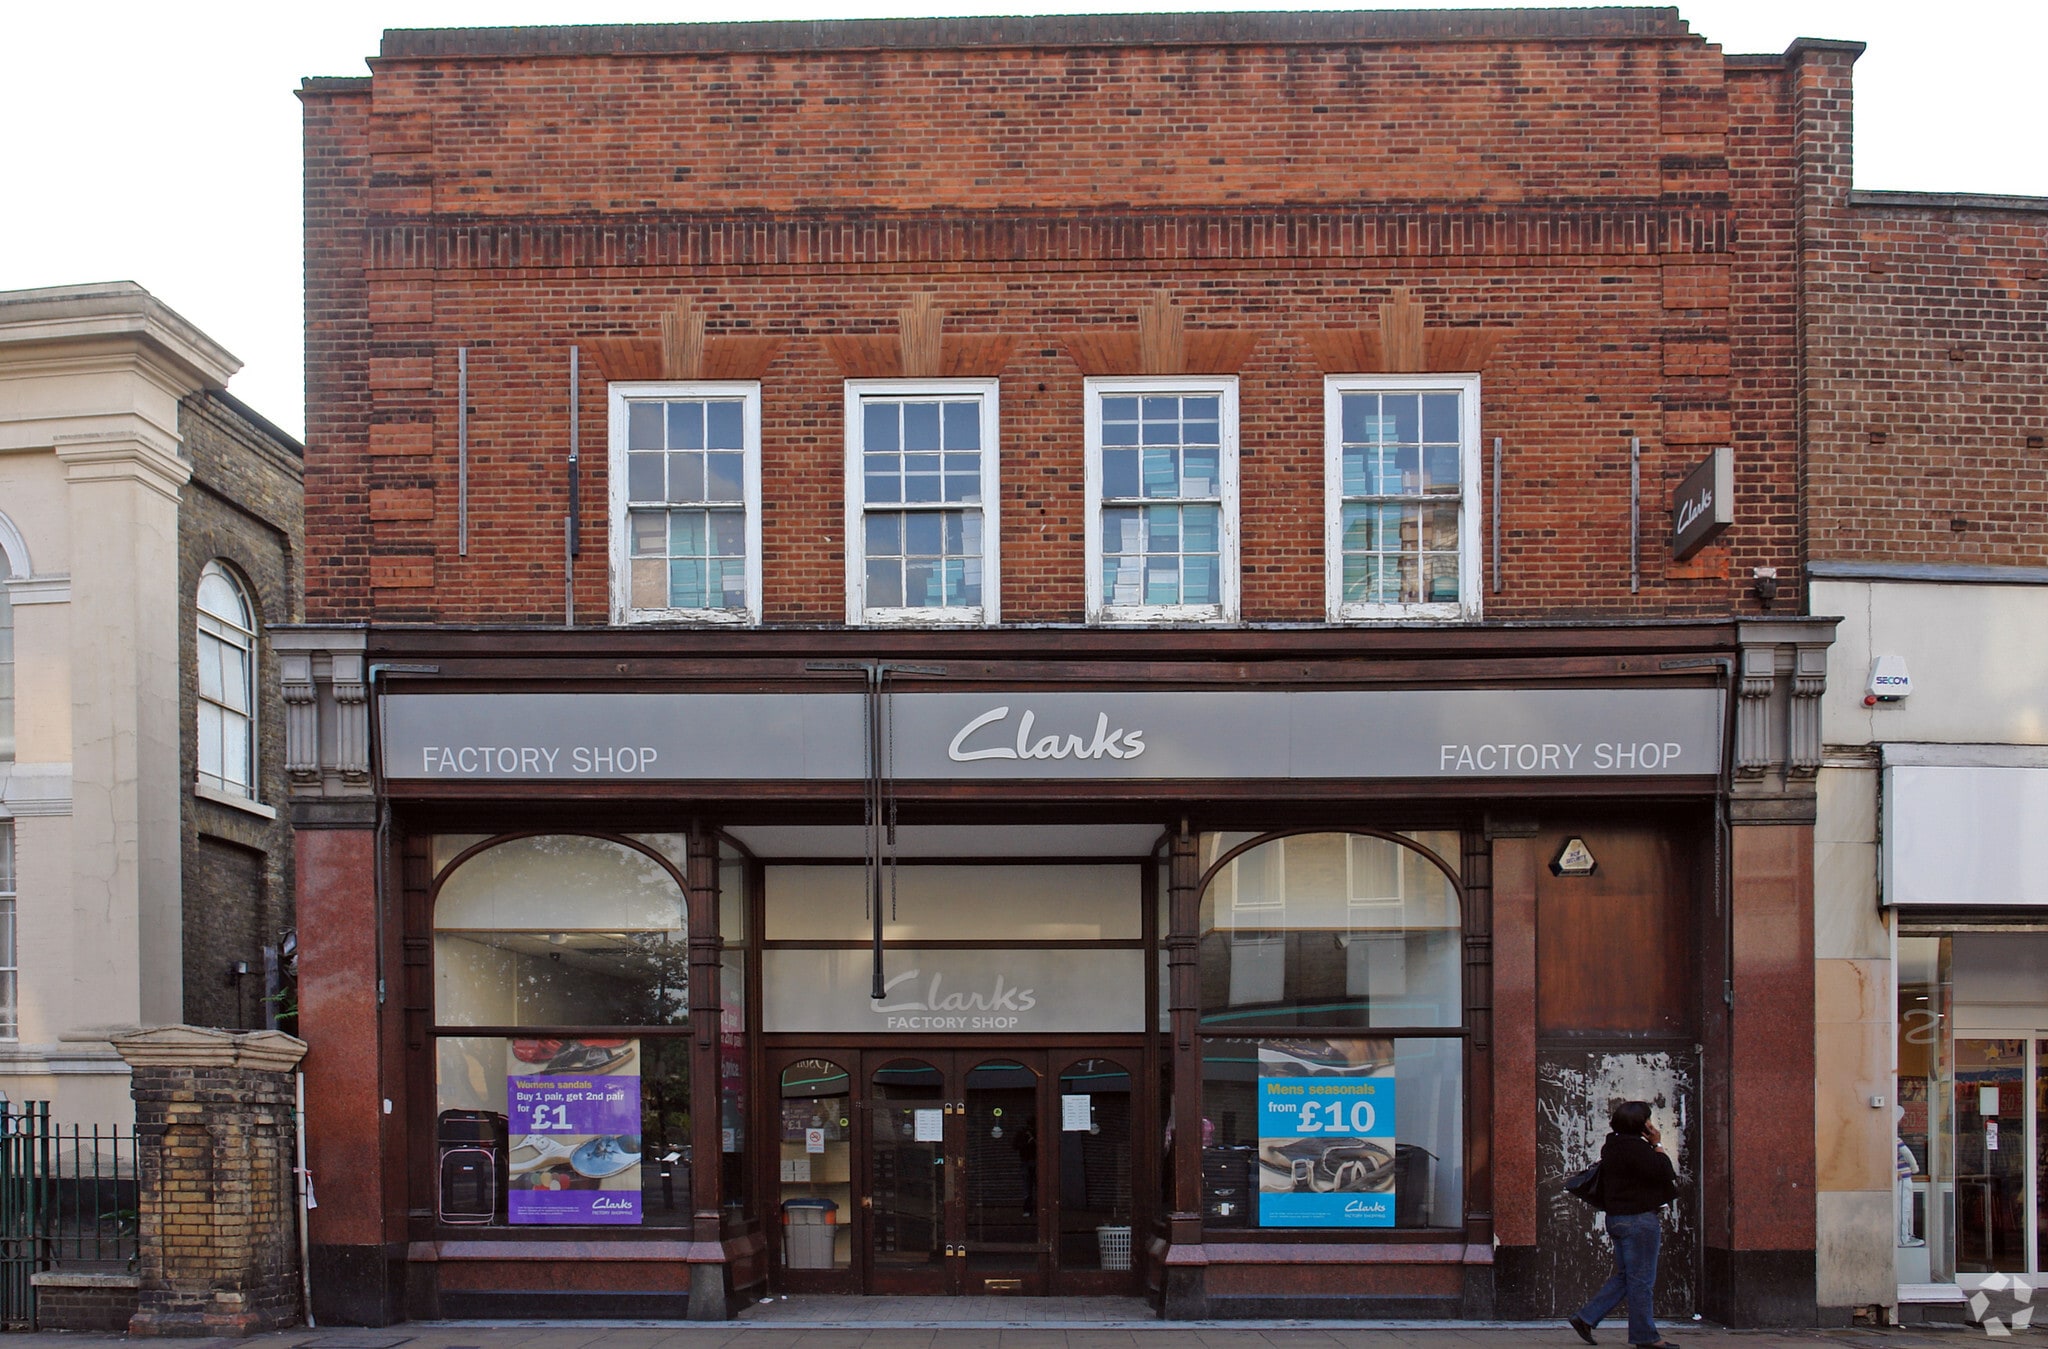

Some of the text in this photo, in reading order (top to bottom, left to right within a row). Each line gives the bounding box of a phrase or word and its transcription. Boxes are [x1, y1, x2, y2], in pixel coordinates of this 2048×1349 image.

[1677, 487, 1713, 535] Clarks
[1876, 676, 1908, 685] SECOM
[948, 706, 1146, 761] Clarks
[423, 746, 658, 773] FACTORY SHOP
[1440, 742, 1681, 771] FACTORY SHOP
[871, 969, 1036, 1013] Clarks
[887, 1016, 1018, 1029] FACTORY SHOP
[516, 1081, 593, 1089] Womens sandals
[1267, 1083, 1375, 1095] Mens seasonals
[516, 1092, 624, 1102] Buy 1 pair, get 2nd pair
[517, 1103, 573, 1130] for £1
[1268, 1101, 1376, 1132] from £10
[591, 1197, 633, 1209] Clarks
[1344, 1200, 1386, 1212] Clarks
